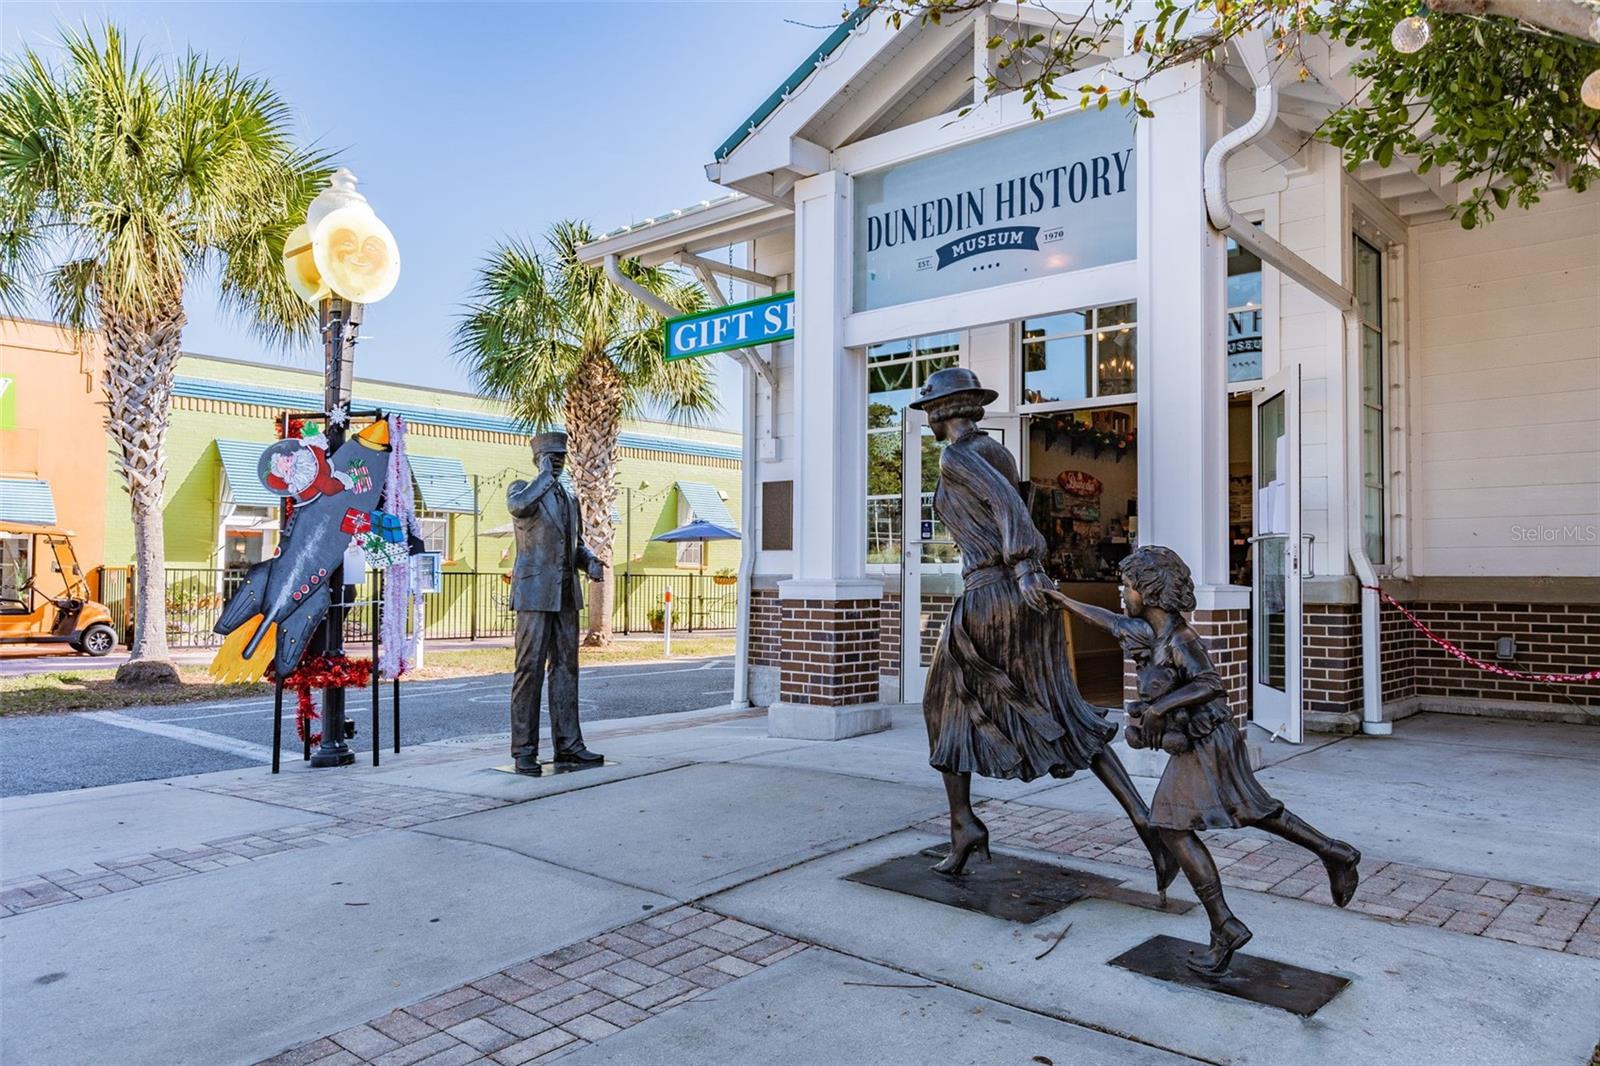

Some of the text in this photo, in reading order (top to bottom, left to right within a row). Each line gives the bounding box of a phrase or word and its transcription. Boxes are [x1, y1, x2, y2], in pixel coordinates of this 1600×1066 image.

[867, 148, 1133, 253] DUNEDIN HISTORY
[951, 231, 1024, 258] MUSEUM
[1044, 230, 1064, 241] 1970
[917, 260, 932, 269] EST.
[674, 310, 754, 351] GIFT
